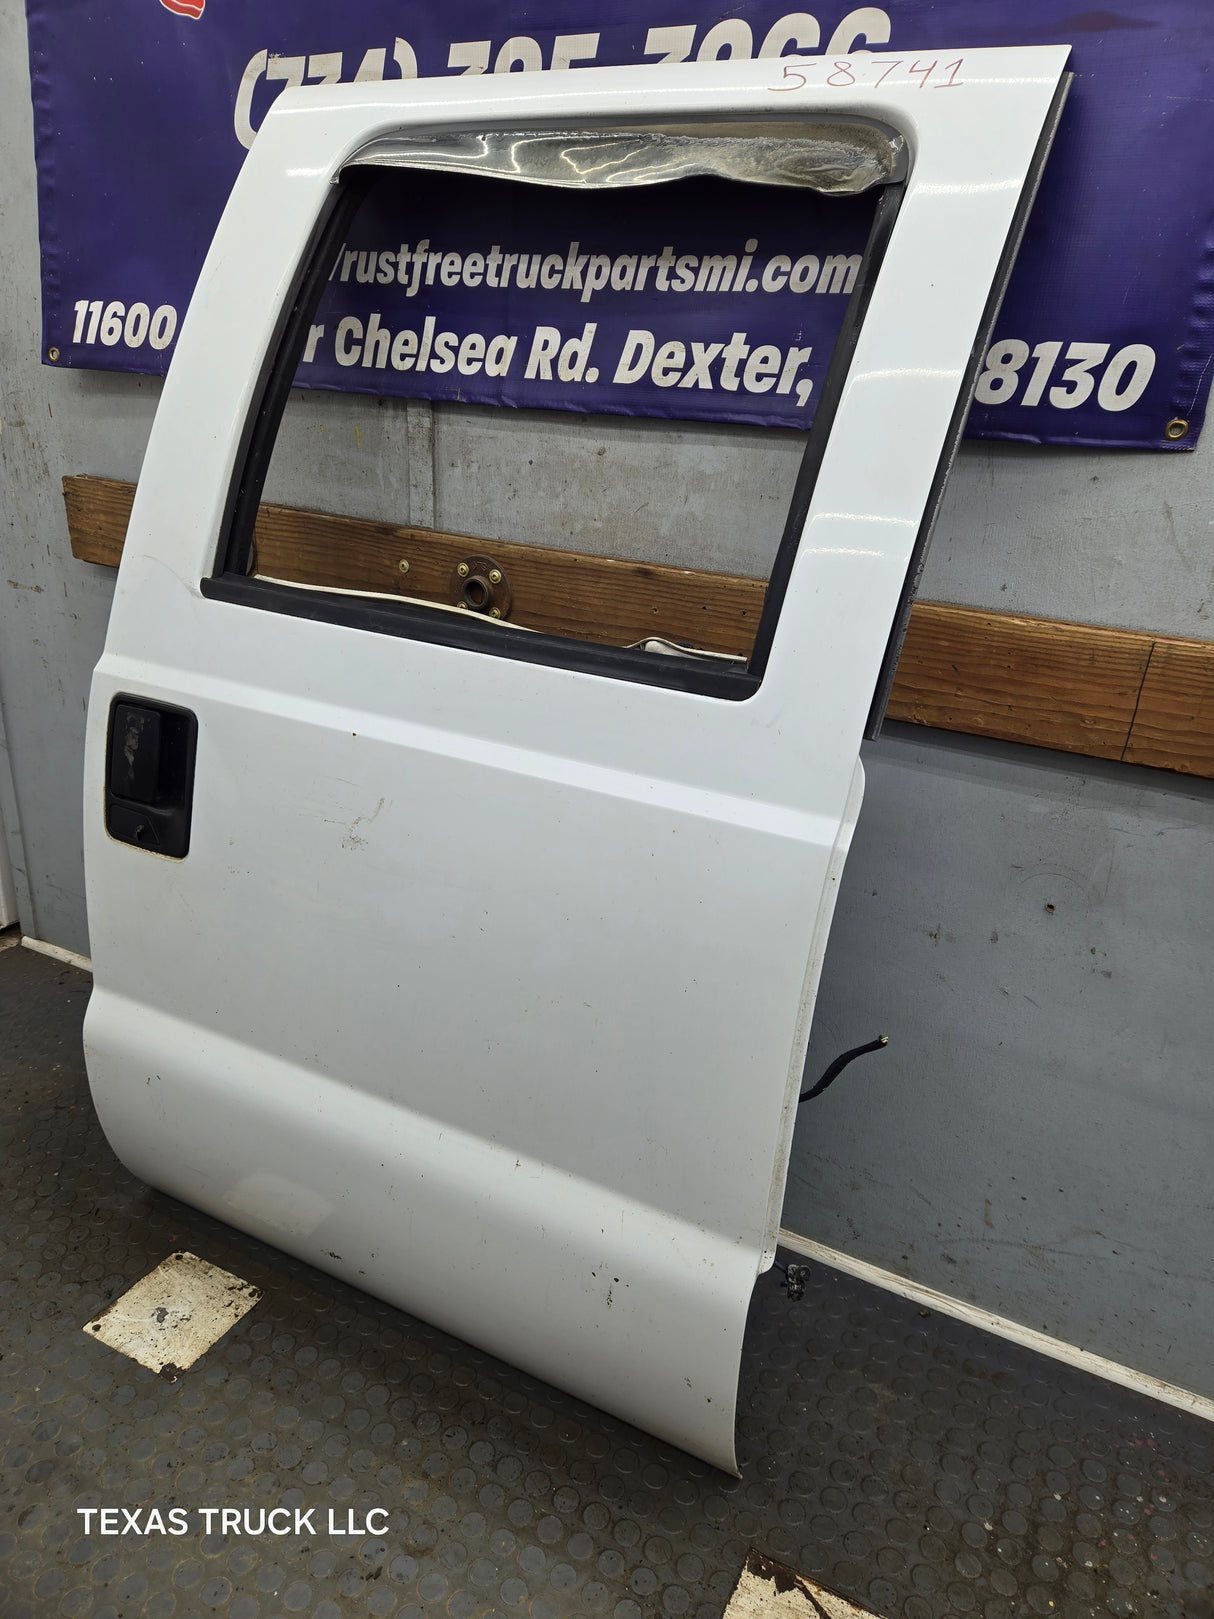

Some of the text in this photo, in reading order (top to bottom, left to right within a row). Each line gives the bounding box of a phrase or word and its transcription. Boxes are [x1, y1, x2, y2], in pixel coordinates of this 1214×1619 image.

[767, 58, 965, 92] 58741
[72, 299, 178, 350] 11600
[334, 313, 519, 377] Chelsea
[523, 322, 599, 383] Rd.
[612, 329, 814, 407] Dexter,
